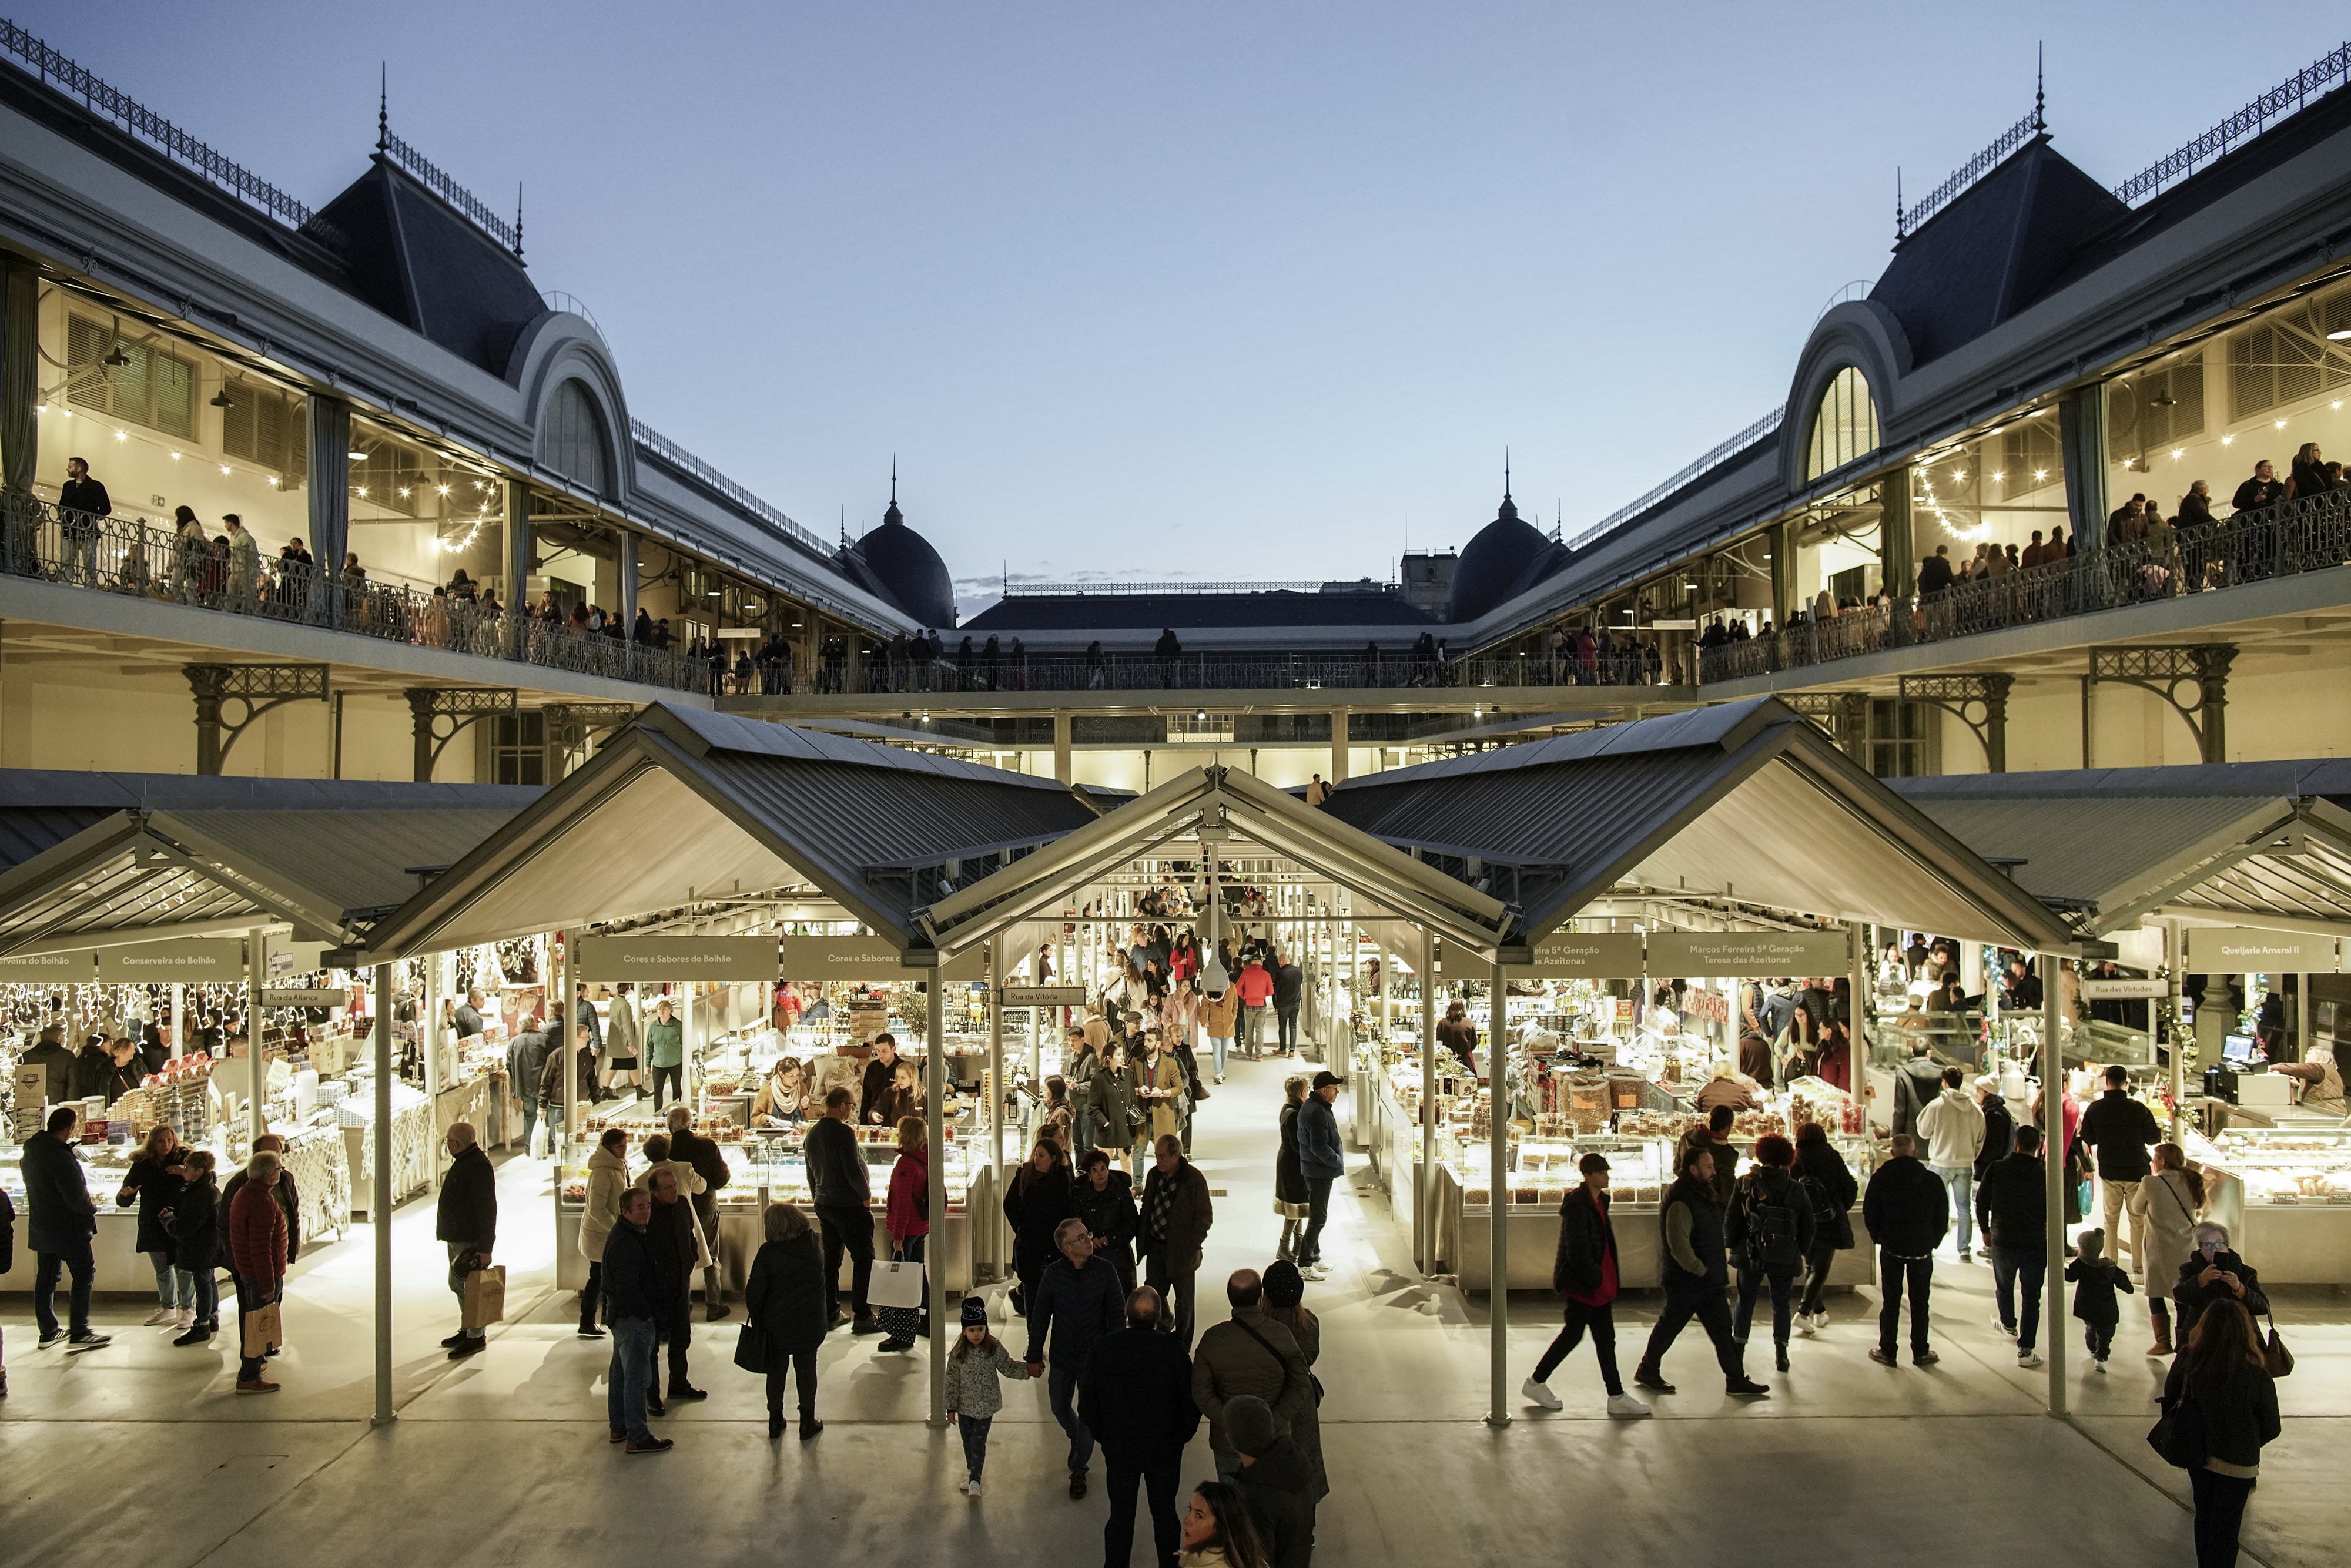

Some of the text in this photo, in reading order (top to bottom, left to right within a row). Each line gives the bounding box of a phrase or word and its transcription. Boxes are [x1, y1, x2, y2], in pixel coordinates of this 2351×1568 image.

[1563, 946, 1599, 956] Geração
[1690, 945, 1720, 953] Marcos
[1722, 945, 1755, 953] Ferreira
[1769, 944, 1804, 954] Geração
[2221, 946, 2260, 956] Queijaria
[122, 956, 216, 964] Conserveira do Bolhão
[624, 954, 648, 963] Cores
[657, 954, 689, 963] Sabores
[691, 954, 702, 963] do
[704, 954, 731, 963] Bolhão
[828, 954, 853, 962] Cores
[861, 954, 894, 962] Sabores
[1543, 957, 1585, 965] Azeitonas
[1704, 956, 1731, 964] Teresa
[1749, 956, 1790, 964] Azeitonas
[293, 994, 318, 1002] Aliança
